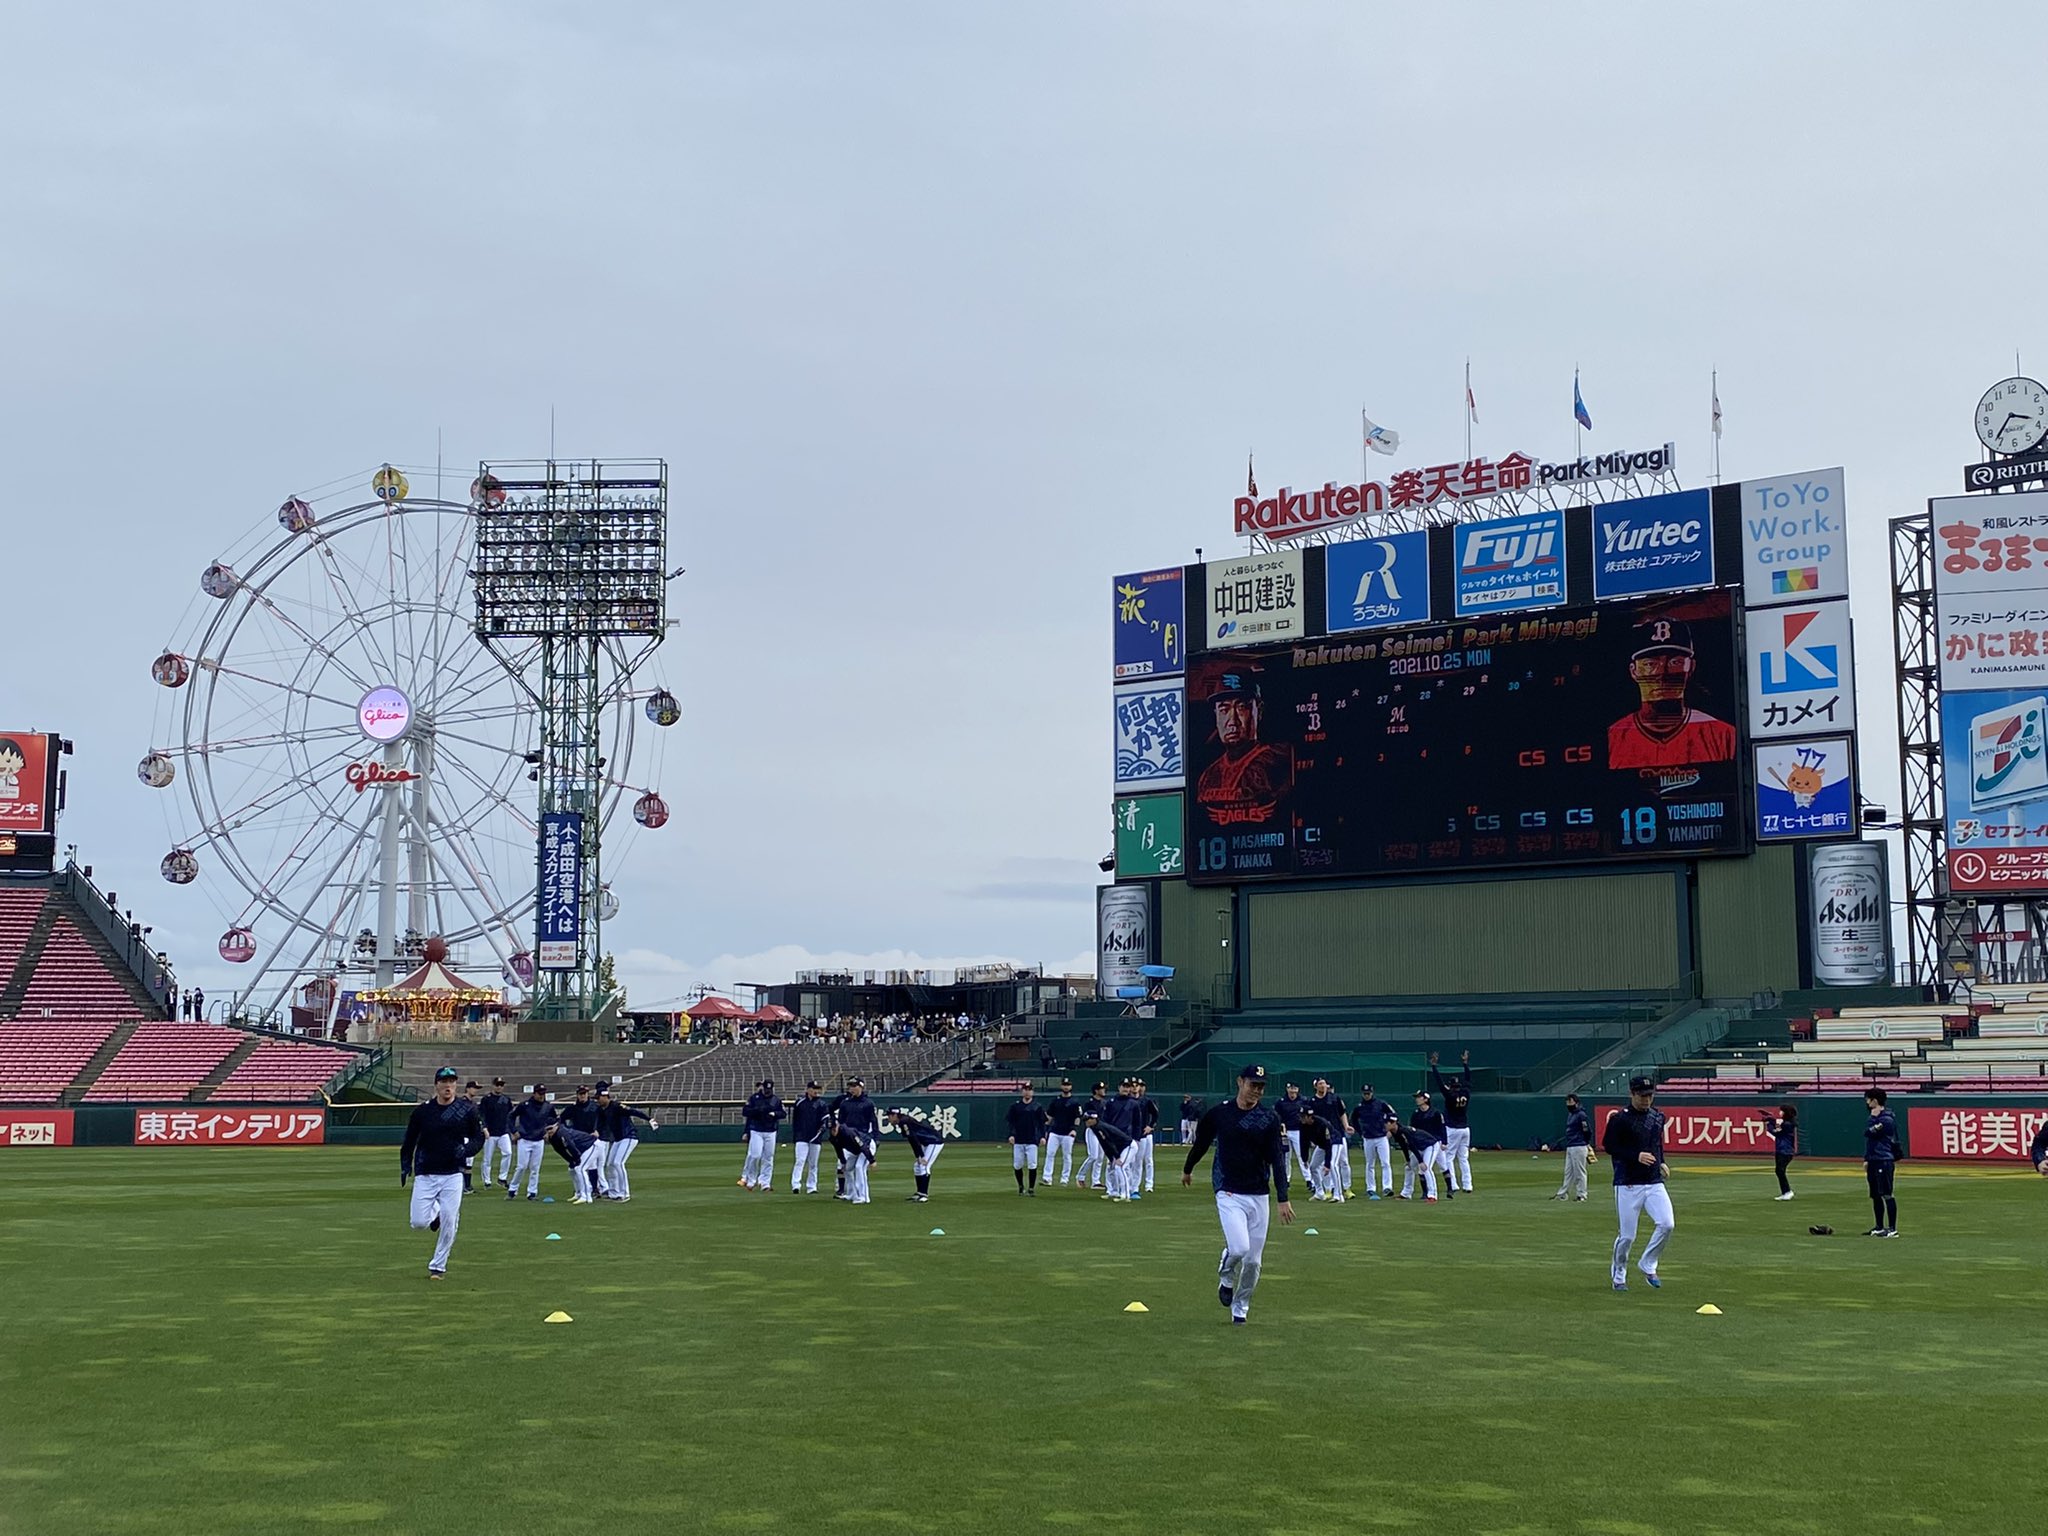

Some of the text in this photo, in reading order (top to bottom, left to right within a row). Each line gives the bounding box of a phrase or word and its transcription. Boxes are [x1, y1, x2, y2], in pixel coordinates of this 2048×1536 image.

[1994, 391, 2002, 401] 11
[2008, 384, 2017, 394] 12
[2024, 385, 2028, 395] 1
[2033, 393, 2040, 403] 2
[1984, 402, 1994, 412] 10
[2039, 406, 2044, 416] 3
[1983, 416, 1989, 426] 9
[2035, 420, 2041, 430] 4
[1987, 429, 1994, 439] 8
[1998, 437, 2004, 447] 7
[2012, 438, 2018, 448] 6
[2025, 432, 2032, 442] 5
[1234, 443, 1672, 534] Rakuten 楽天生命 Park Miyagi
[1603, 519, 1702, 554] Yurtec
[1748, 509, 1841, 543] Work.
[1461, 519, 1558, 569] Fuji
[1757, 543, 1832, 565] Group
[1223, 560, 1285, 578] 人と暮らしをつなぐ
[1604, 549, 1702, 574] 株式会社 ユアテック
[1214, 573, 1297, 619] 中田建設
[1352, 602, 1401, 622] ろうきん
[1292, 611, 1599, 669] Rakuten Seimei Park Miyagi
[1945, 629, 2048, 662] かに政
[1389, 648, 1492, 676] 2021.10.25 MON
[1970, 664, 2046, 675] KANIMASAMUNE
[1295, 702, 1319, 713] 10/25
[1335, 699, 1347, 710] 26
[1376, 695, 1389, 705] 27
[1419, 690, 1431, 701] 28
[1463, 685, 1476, 696] 29
[1508, 681, 1520, 691] 30
[1118, 691, 1182, 737] 阿部
[1763, 694, 1841, 729] カメイ
[1518, 745, 1592, 767] CS CS
[1217, 807, 1266, 826] EAGLES
[1475, 814, 1501, 831] CS
[1519, 811, 1547, 828] CS
[1565, 807, 1594, 825] CS
[1620, 806, 1657, 845] 18
[1666, 802, 1724, 821] YOSHINOBU
[1781, 812, 1848, 829] 七十七銀行
[1198, 832, 1285, 871] 18 MASAHIRO
[1232, 853, 1273, 869] TANAKA
[543, 822, 560, 935] 京成スカイライナー
[558, 841, 577, 934] 成田空港へは
[1819, 894, 1881, 925] Asahi
[1103, 927, 1146, 953] Asahi
[1841, 928, 1860, 941] 生
[1117, 955, 1131, 966] 生
[12, 1125, 53, 1142] ネット
[138, 1111, 324, 1142] 東京インテリア
[1663, 1115, 1776, 1146] イリスオーヤ
